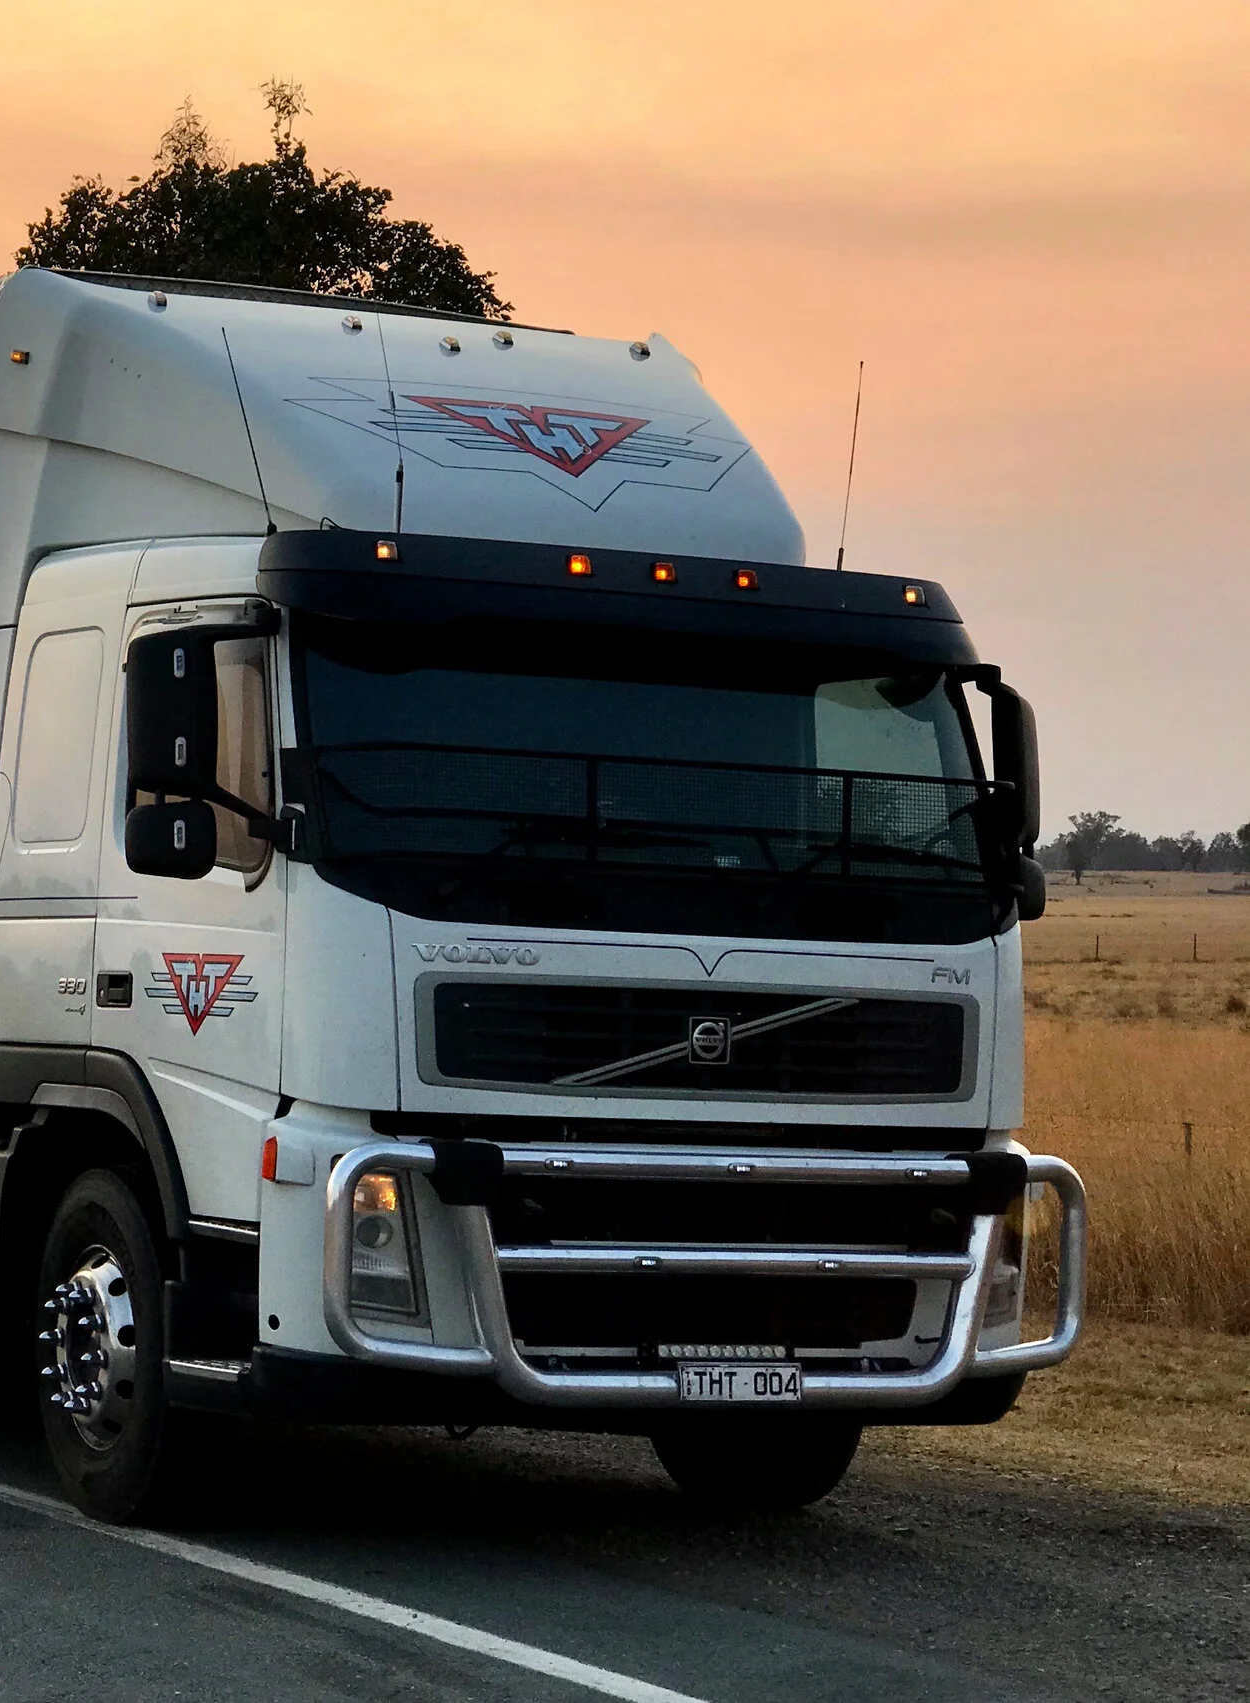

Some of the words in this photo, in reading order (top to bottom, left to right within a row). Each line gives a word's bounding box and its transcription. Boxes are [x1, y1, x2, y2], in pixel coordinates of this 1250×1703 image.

[442, 403, 625, 462] THT
[411, 942, 541, 966] VOLVO
[931, 966, 972, 986] FM
[170, 961, 232, 1018] THT
[684, 1370, 693, 1396] TAS
[693, 1370, 738, 1396] THT
[753, 1370, 799, 1396] 004
